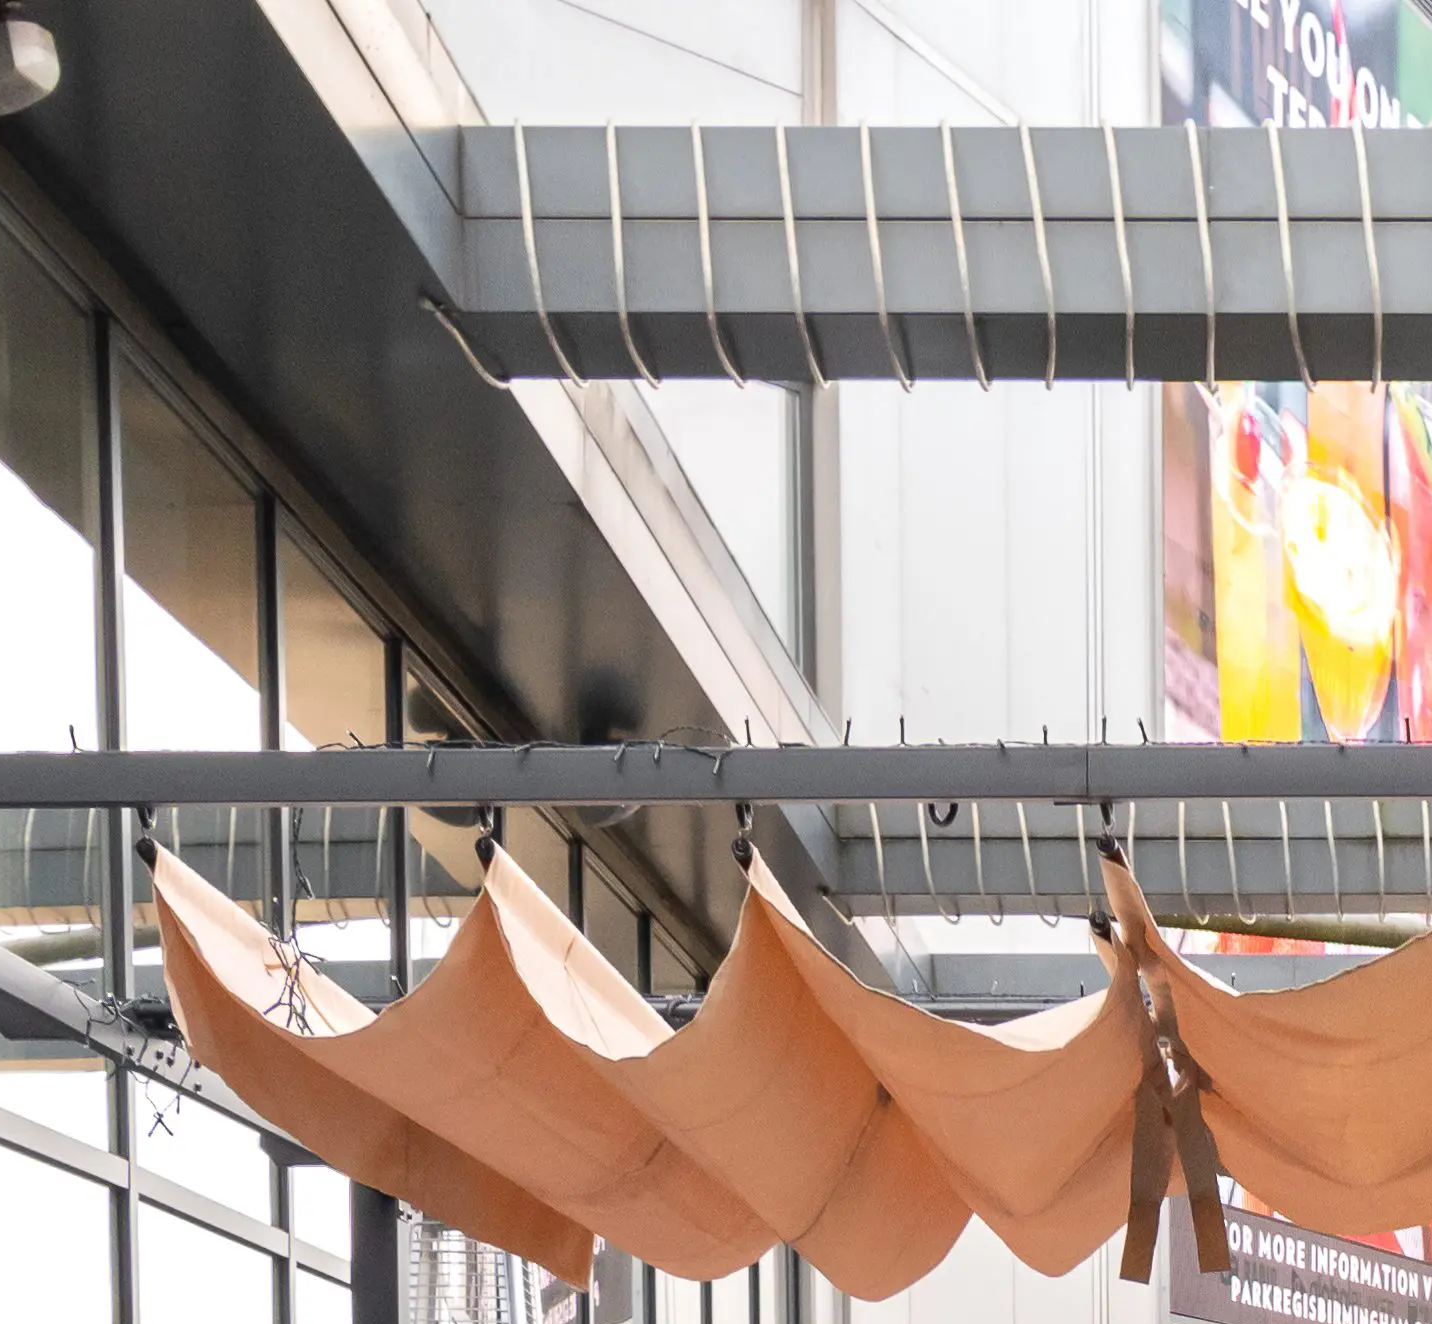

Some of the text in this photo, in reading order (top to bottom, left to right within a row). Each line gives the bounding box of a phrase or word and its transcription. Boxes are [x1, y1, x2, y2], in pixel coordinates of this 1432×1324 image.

[1280, 0, 1351, 100] YOU
[1225, 1219, 1253, 1256] OR
[1258, 1230, 1306, 1270] MORE
[1310, 1244, 1419, 1298] INFORMATION
